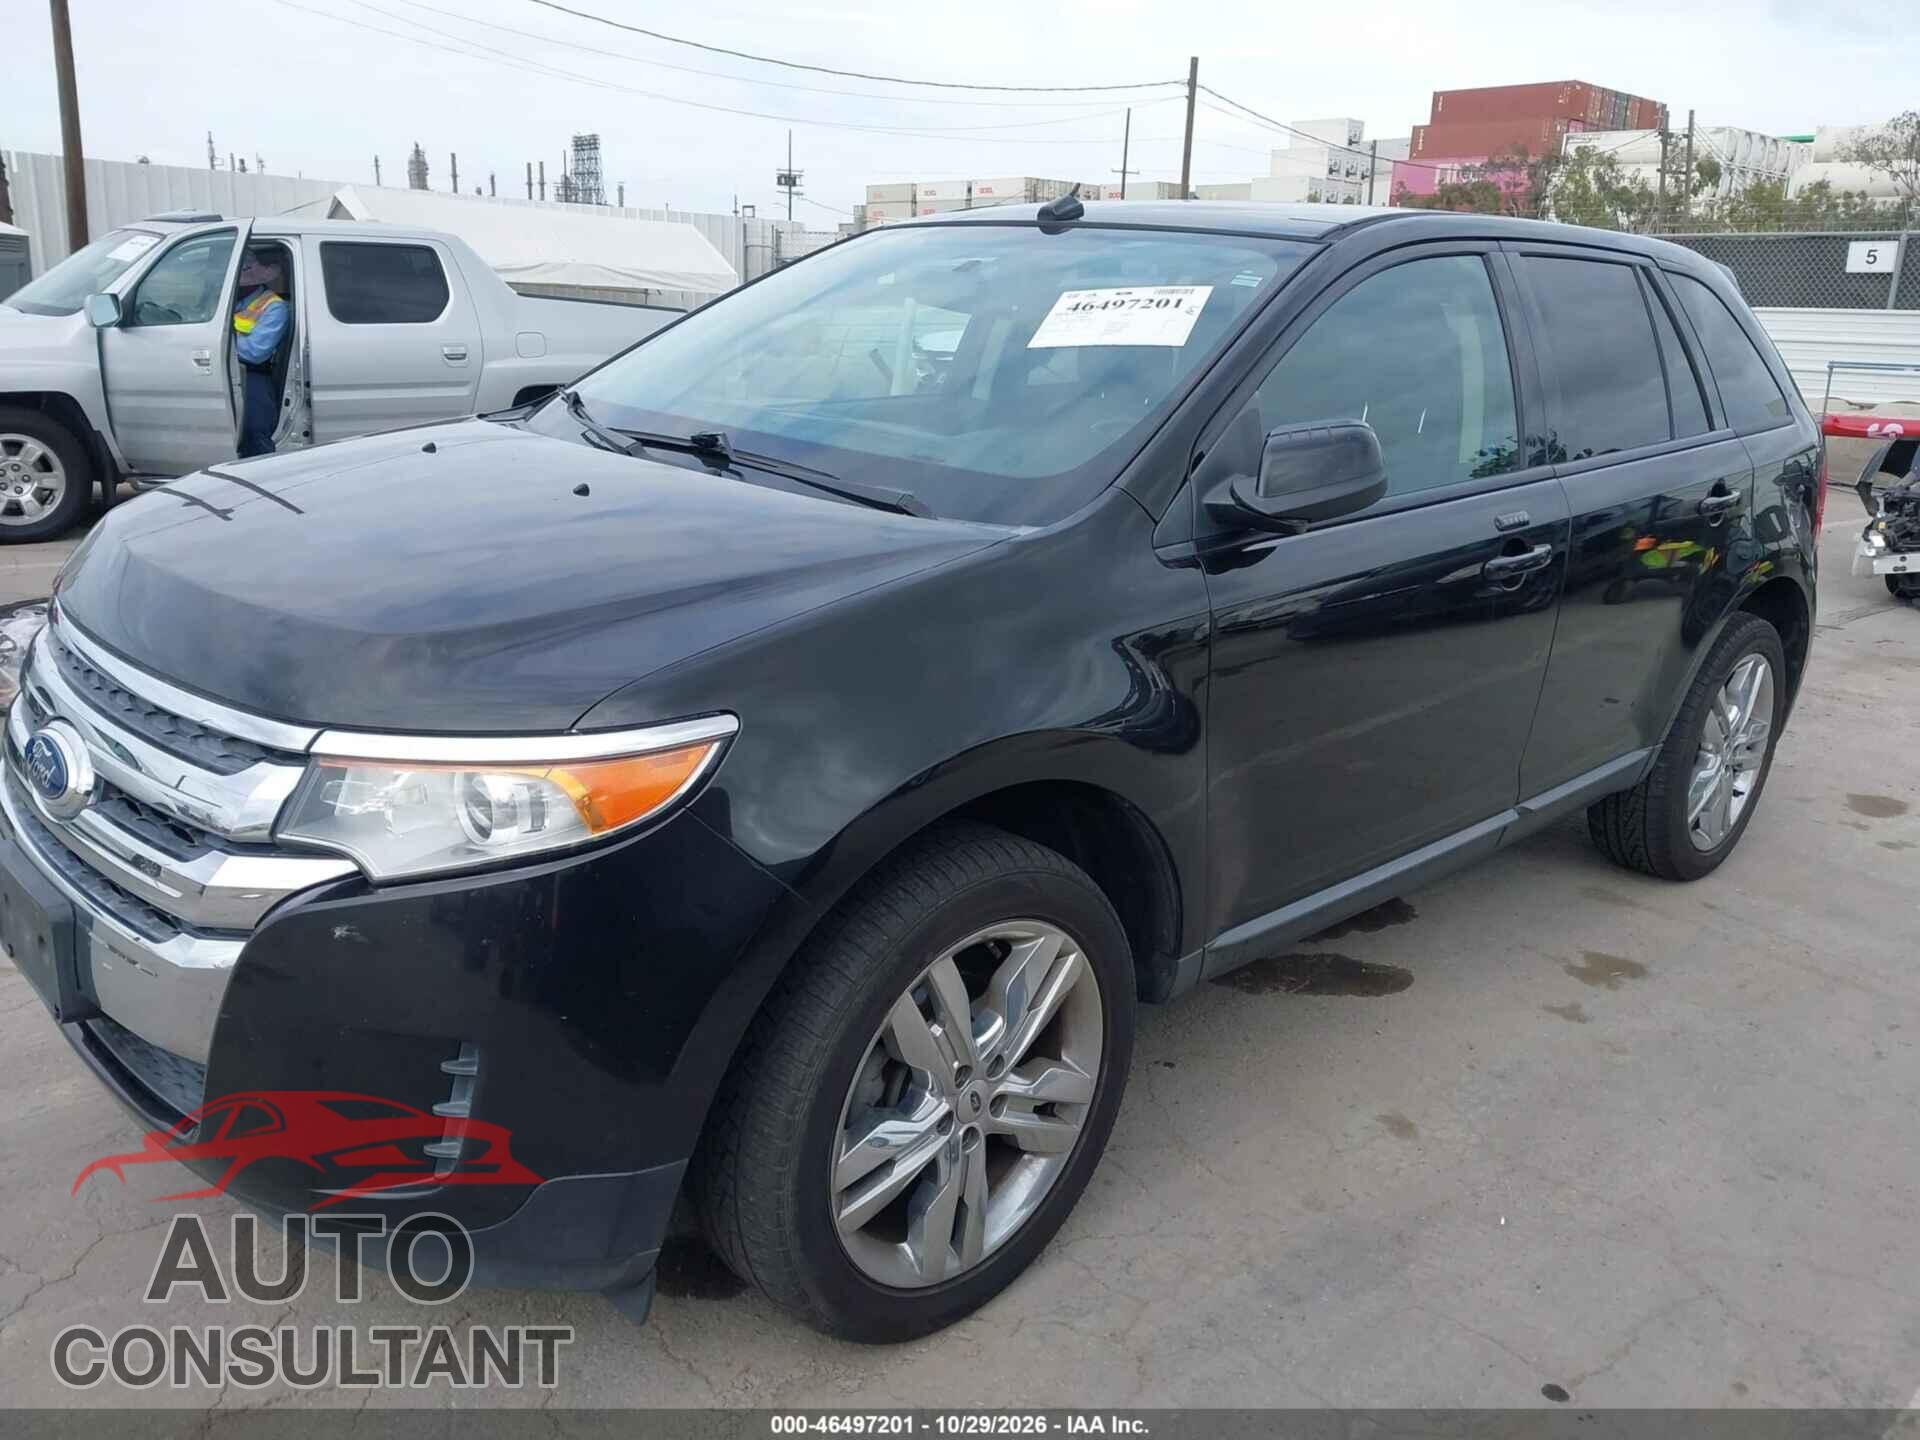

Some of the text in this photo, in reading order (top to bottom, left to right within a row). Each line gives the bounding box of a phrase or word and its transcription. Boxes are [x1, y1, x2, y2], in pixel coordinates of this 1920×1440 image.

[1865, 249, 1878, 265] 5
[1066, 298, 1184, 313] 46497201
[25, 739, 57, 789] Ford
